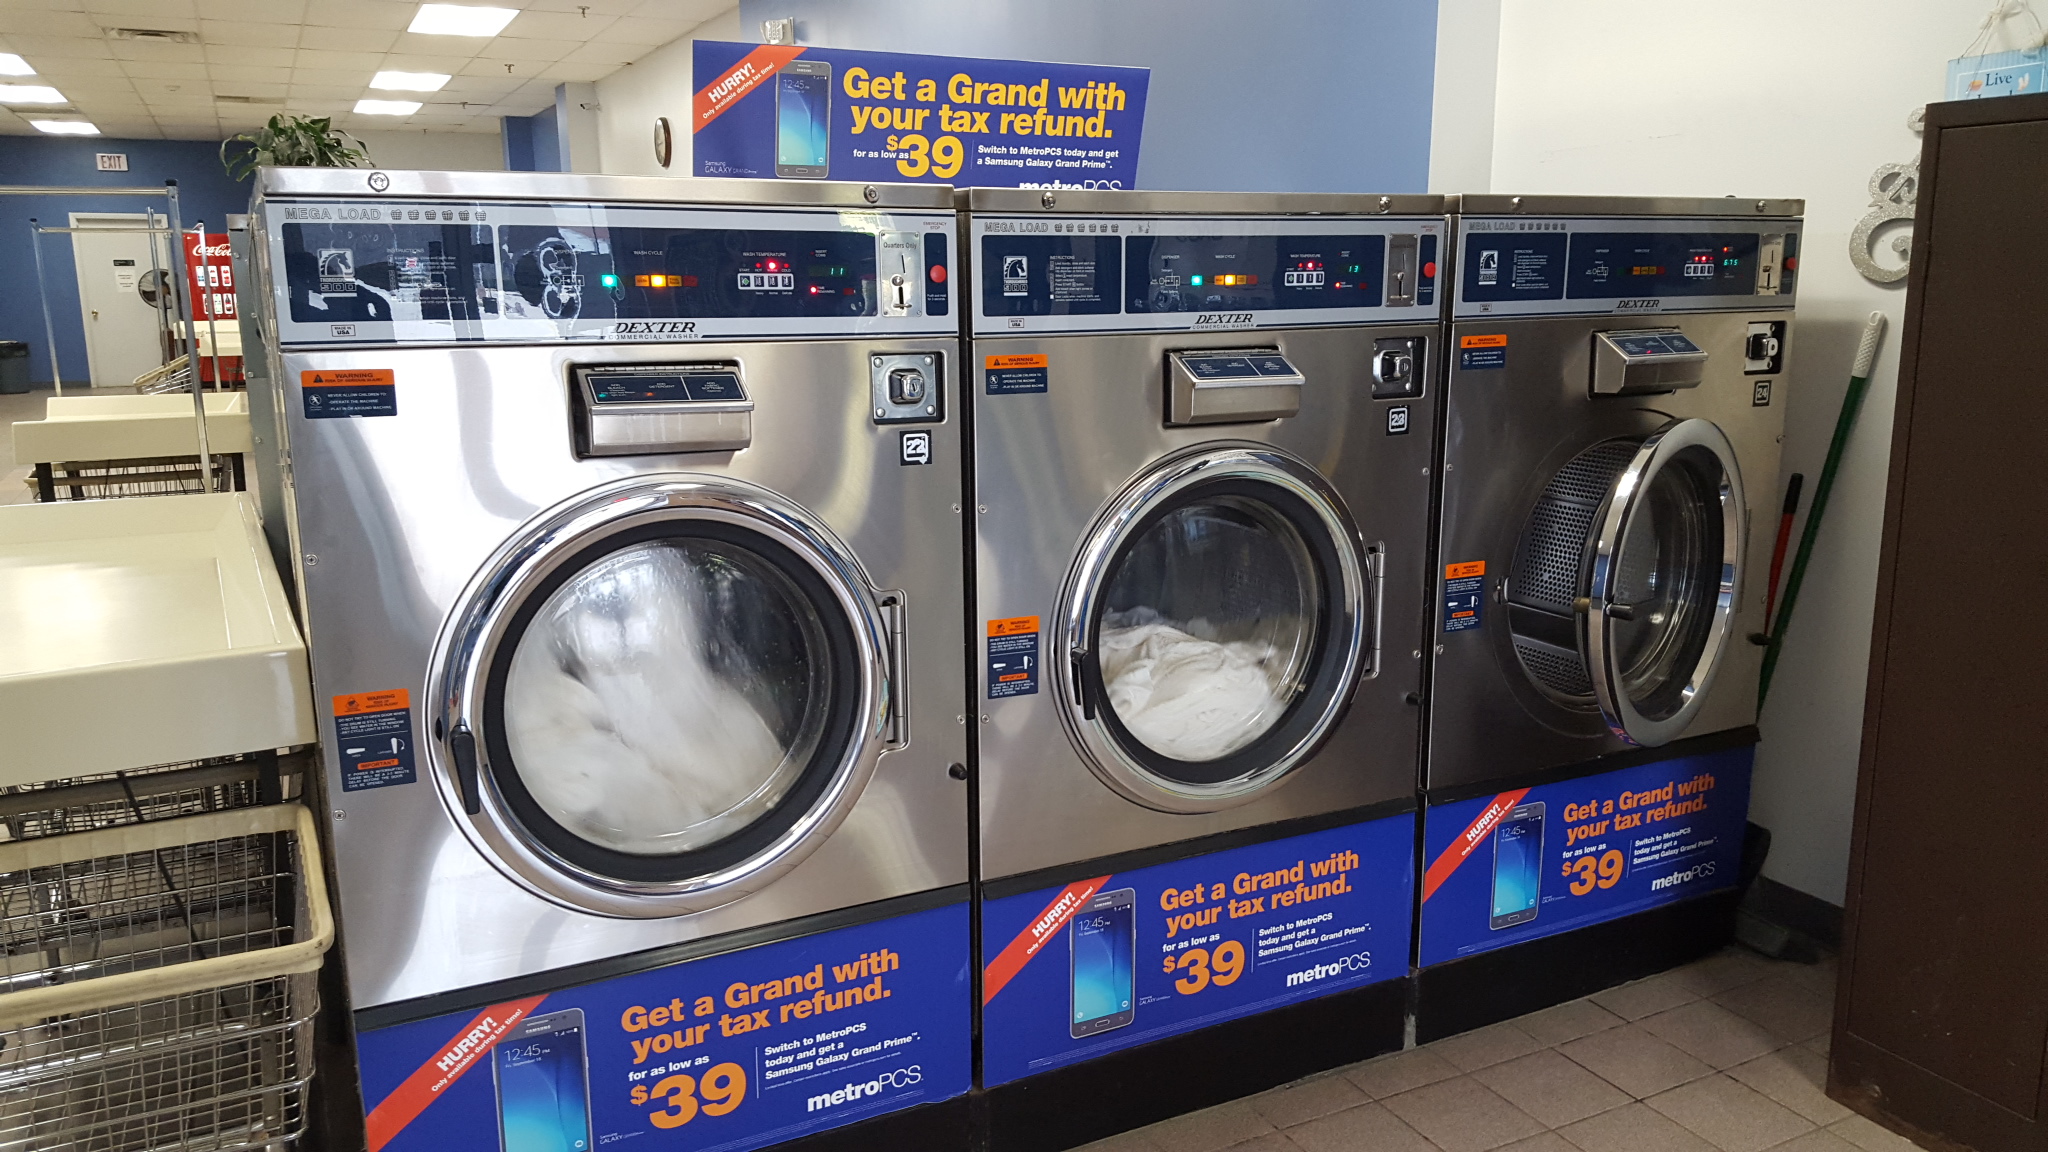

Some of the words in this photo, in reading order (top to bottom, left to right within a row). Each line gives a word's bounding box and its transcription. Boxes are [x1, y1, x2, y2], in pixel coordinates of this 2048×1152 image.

[703, 108, 715, 119] Only
[715, 92, 736, 110] available
[736, 79, 754, 94] during
[753, 73, 762, 82] tax
[760, 62, 775, 76] time!
[708, 62, 756, 102] HURRY!
[843, 67, 906, 100] Get
[916, 79, 936, 102] a
[948, 72, 1052, 107] Grand
[1058, 80, 1125, 111] with
[1985, 73, 2013, 87] Live
[850, 106, 930, 134] your
[939, 104, 988, 133] tax
[1000, 109, 1112, 138] refund.
[100, 155, 122, 169] EXIT
[853, 149, 866, 158] for
[881, 150, 897, 158] low
[898, 151, 909, 159] as
[886, 134, 964, 178] $39
[977, 145, 1007, 154] Switch
[1009, 146, 1018, 154] to
[1020, 146, 1062, 156] MetroPCS
[1064, 148, 1086, 158] today
[1088, 149, 1103, 157] and
[1105, 150, 1119, 159] get
[984, 157, 1024, 167] Samsung
[1026, 158, 1053, 168] Galaxy
[1055, 159, 1080, 168] Grand
[705, 166, 732, 174] GALAXY
[285, 207, 332, 219] MEGA
[338, 208, 381, 220] LOAD
[984, 222, 1015, 233] MEGA
[1019, 222, 1048, 233] LOAD
[1468, 222, 1491, 230] MEGA
[1493, 222, 1515, 230] LOAD
[1616, 299, 1659, 308] DEXTER
[611, 322, 695, 333] DEXTER
[1195, 313, 1253, 324] DEXTER
[1757, 389, 1768, 398] 24
[1391, 413, 1404, 426] 23
[906, 438, 926, 454] 22
[361, 760, 395, 768] IMPORTANT
[1564, 801, 1598, 823] Get
[1603, 800, 1613, 813] a
[1619, 782, 1674, 811] Grand
[1678, 774, 1714, 796] with
[1466, 804, 1501, 841] HURRY!
[1566, 818, 1610, 846] your
[1614, 810, 1642, 829] tax
[1646, 795, 1707, 824] refund.
[1634, 847, 1650, 856] today
[1651, 843, 1662, 851] and
[1663, 841, 1673, 850] get
[1635, 836, 1655, 847] Switch
[1663, 827, 1691, 840] MetroPCS
[1584, 845, 1597, 854] low
[1633, 852, 1660, 864] Samsung
[1661, 847, 1679, 857] Galaxy
[1680, 842, 1697, 852] Grand
[1160, 885, 1204, 911] Get
[1211, 882, 1225, 901] a
[1233, 860, 1302, 896] Grand
[1310, 850, 1359, 878] with
[1562, 850, 1624, 896] $39
[1652, 861, 1716, 891] metroPCS
[1032, 892, 1076, 937] HURRY!
[1166, 905, 1222, 938] your
[1228, 894, 1264, 920] tax
[1271, 874, 1351, 909] refund.
[1026, 942, 1039, 955] Only
[1038, 922, 1058, 944] available
[1058, 906, 1074, 923] during
[1073, 899, 1081, 908] tax
[1080, 886, 1094, 900] time!
[1078, 917, 1104, 931] 12:45
[1259, 923, 1284, 936] Switch
[1296, 912, 1332, 928] MetroPCS
[1163, 943, 1176, 952] for
[1191, 937, 1207, 946] low
[1209, 933, 1220, 941] as
[1258, 936, 1280, 946] today
[1281, 931, 1295, 941] and
[1297, 928, 1309, 939] get
[1258, 942, 1293, 957] Samsung
[1294, 936, 1319, 947] Galaxy
[1320, 930, 1343, 941] Grand
[1163, 940, 1245, 995] $39
[1286, 952, 1370, 987] metroPCS
[621, 1005, 684, 1033] Get
[699, 994, 713, 1013] a
[725, 966, 822, 1009] Grand
[836, 948, 899, 984] with
[525, 1025, 551, 1033] SAMSUNG
[631, 1022, 709, 1064] your
[719, 1007, 769, 1039] tax
[780, 976, 890, 1026] refund.
[431, 1077, 447, 1092] Only
[448, 1052, 475, 1079] available
[474, 1034, 497, 1053] during
[495, 1024, 506, 1035] tax
[505, 1008, 523, 1025] time!
[436, 1016, 498, 1072] HURRY!
[765, 1039, 800, 1056] Switch
[803, 1037, 813, 1046] to
[816, 1022, 867, 1043] MetroPCS
[504, 1044, 540, 1061] 12:45
[765, 1054, 794, 1067] today
[797, 1048, 816, 1060] and
[818, 1044, 835, 1057] get
[765, 1061, 813, 1080] Samsung
[816, 1052, 849, 1067] Galaxy
[851, 1043, 881, 1057] Grand
[628, 1071, 647, 1081] for
[650, 1067, 666, 1076] as
[668, 1060, 692, 1072] low
[695, 1055, 710, 1065] as
[630, 1062, 746, 1129] $39
[808, 1065, 921, 1112] metroPCS
